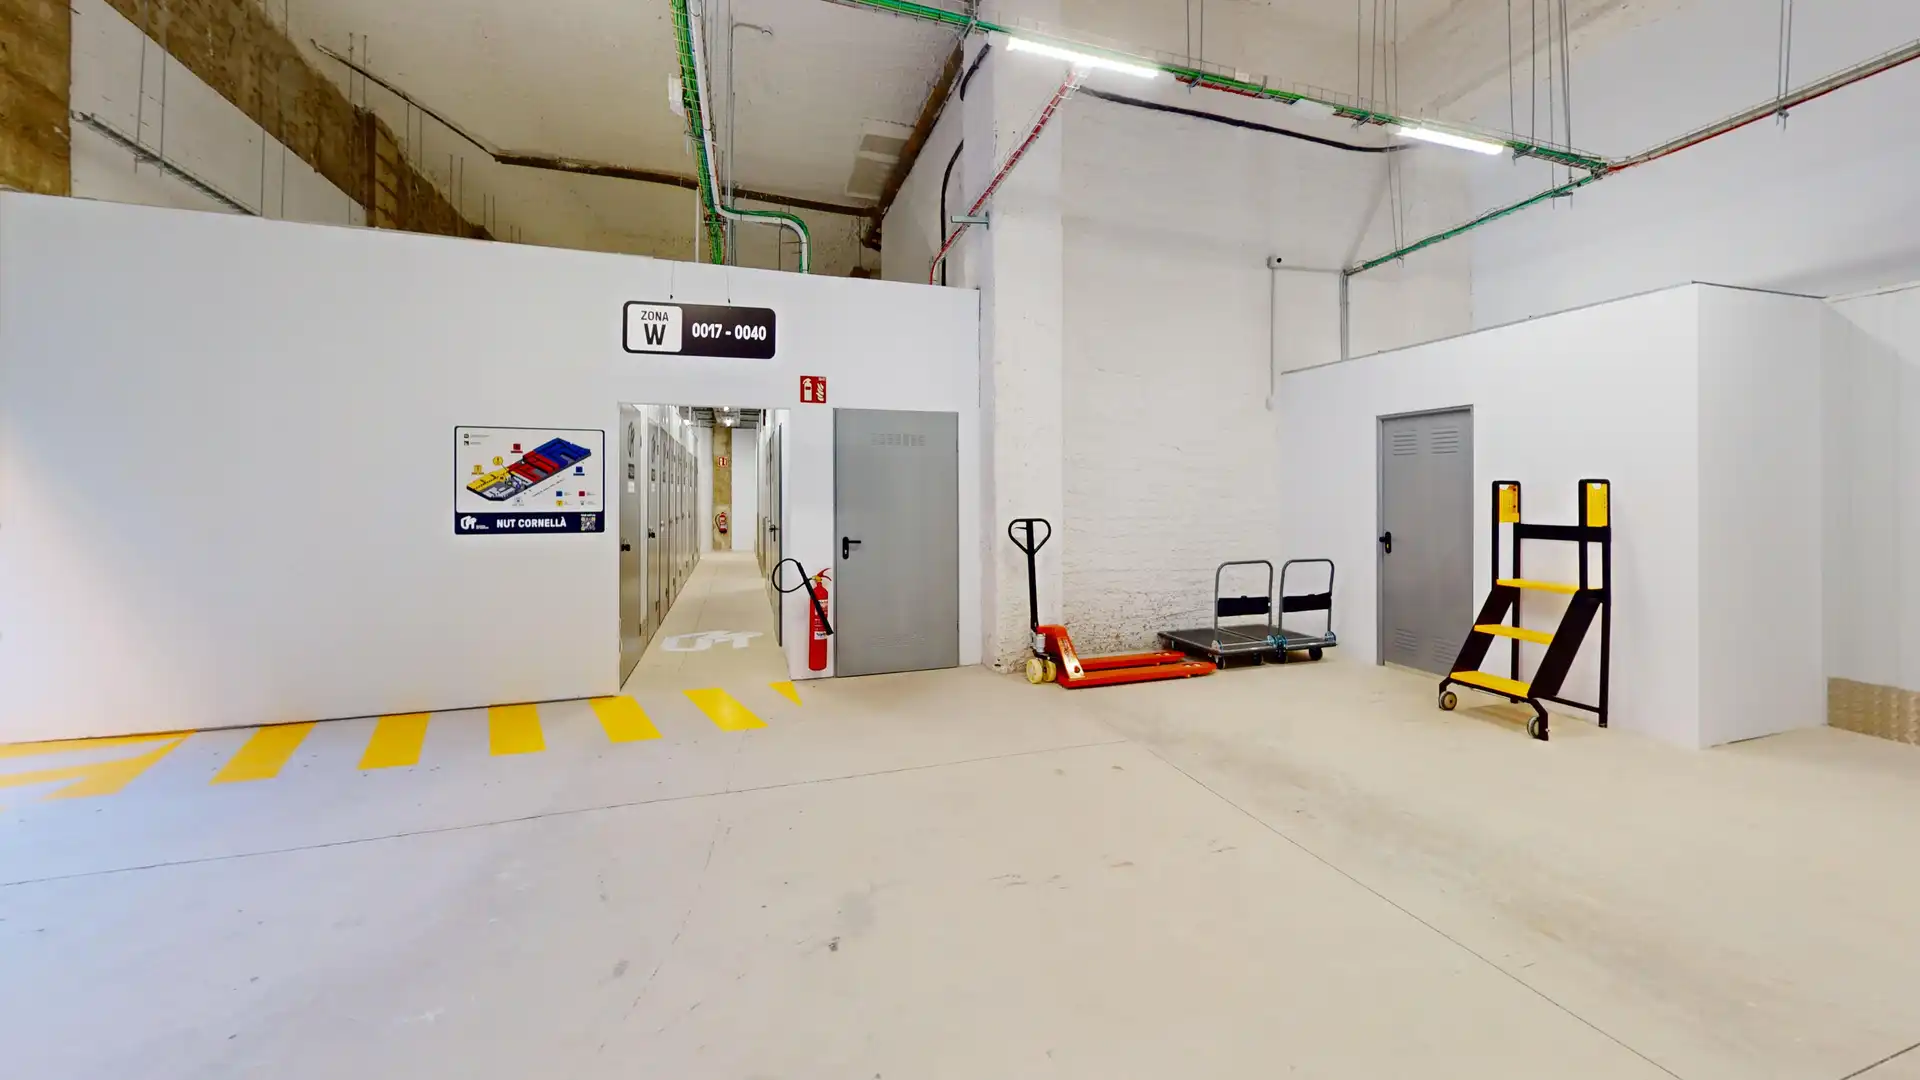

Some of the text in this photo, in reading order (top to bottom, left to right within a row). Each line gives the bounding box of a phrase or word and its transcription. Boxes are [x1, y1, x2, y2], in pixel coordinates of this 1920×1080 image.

[640, 310, 669, 322] ZONA
[644, 323, 667, 346] W
[692, 322, 723, 339] 0017
[734, 324, 767, 341] 0040
[496, 518, 515, 529] NUT
[518, 516, 567, 528] CORNELLÀ
